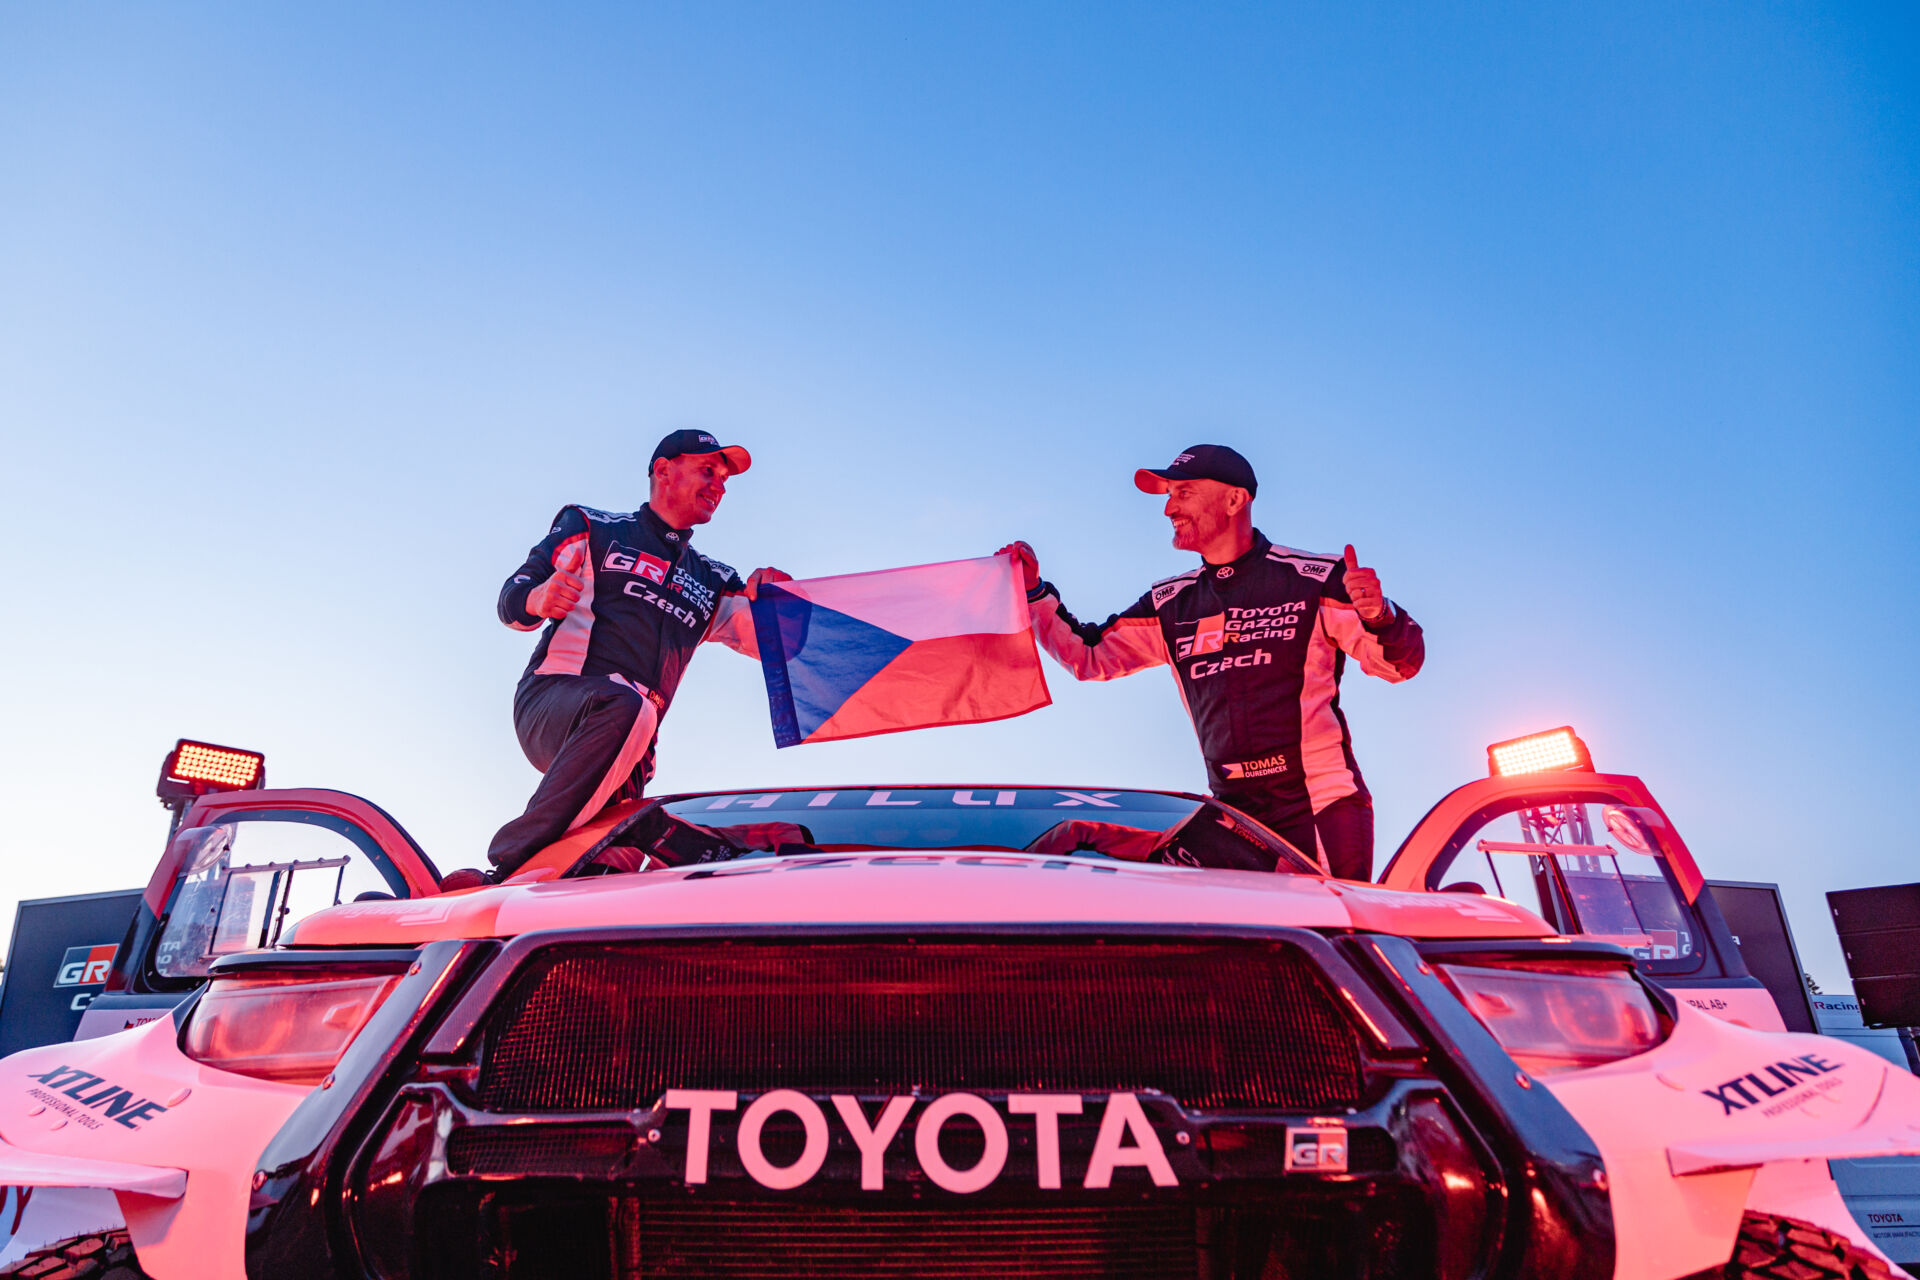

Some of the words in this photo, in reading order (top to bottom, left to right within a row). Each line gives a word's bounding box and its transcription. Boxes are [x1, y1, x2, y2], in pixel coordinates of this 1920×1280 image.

[604, 551, 664, 583] GR
[1302, 564, 1327, 575] OMP
[675, 566, 715, 599] TOYOT
[1155, 586, 1175, 600] OMP
[623, 580, 697, 628] Czech
[1228, 601, 1306, 619] TOYOTA
[1225, 615, 1299, 631] GAZOO
[1224, 628, 1296, 643] Racing
[1190, 649, 1272, 679] Czech
[1242, 754, 1286, 771] TOMAS
[1244, 765, 1288, 778] OUREDNICEK
[706, 790, 1121, 810] HILUX
[58, 960, 110, 984] GR
[1701, 1054, 1845, 1116] XTLINE
[27, 1065, 168, 1129] XTLINE
[666, 1089, 1179, 1193] TOYOTA
[1293, 1143, 1343, 1165] GR
[1867, 1213, 1904, 1223] TOYOTA
